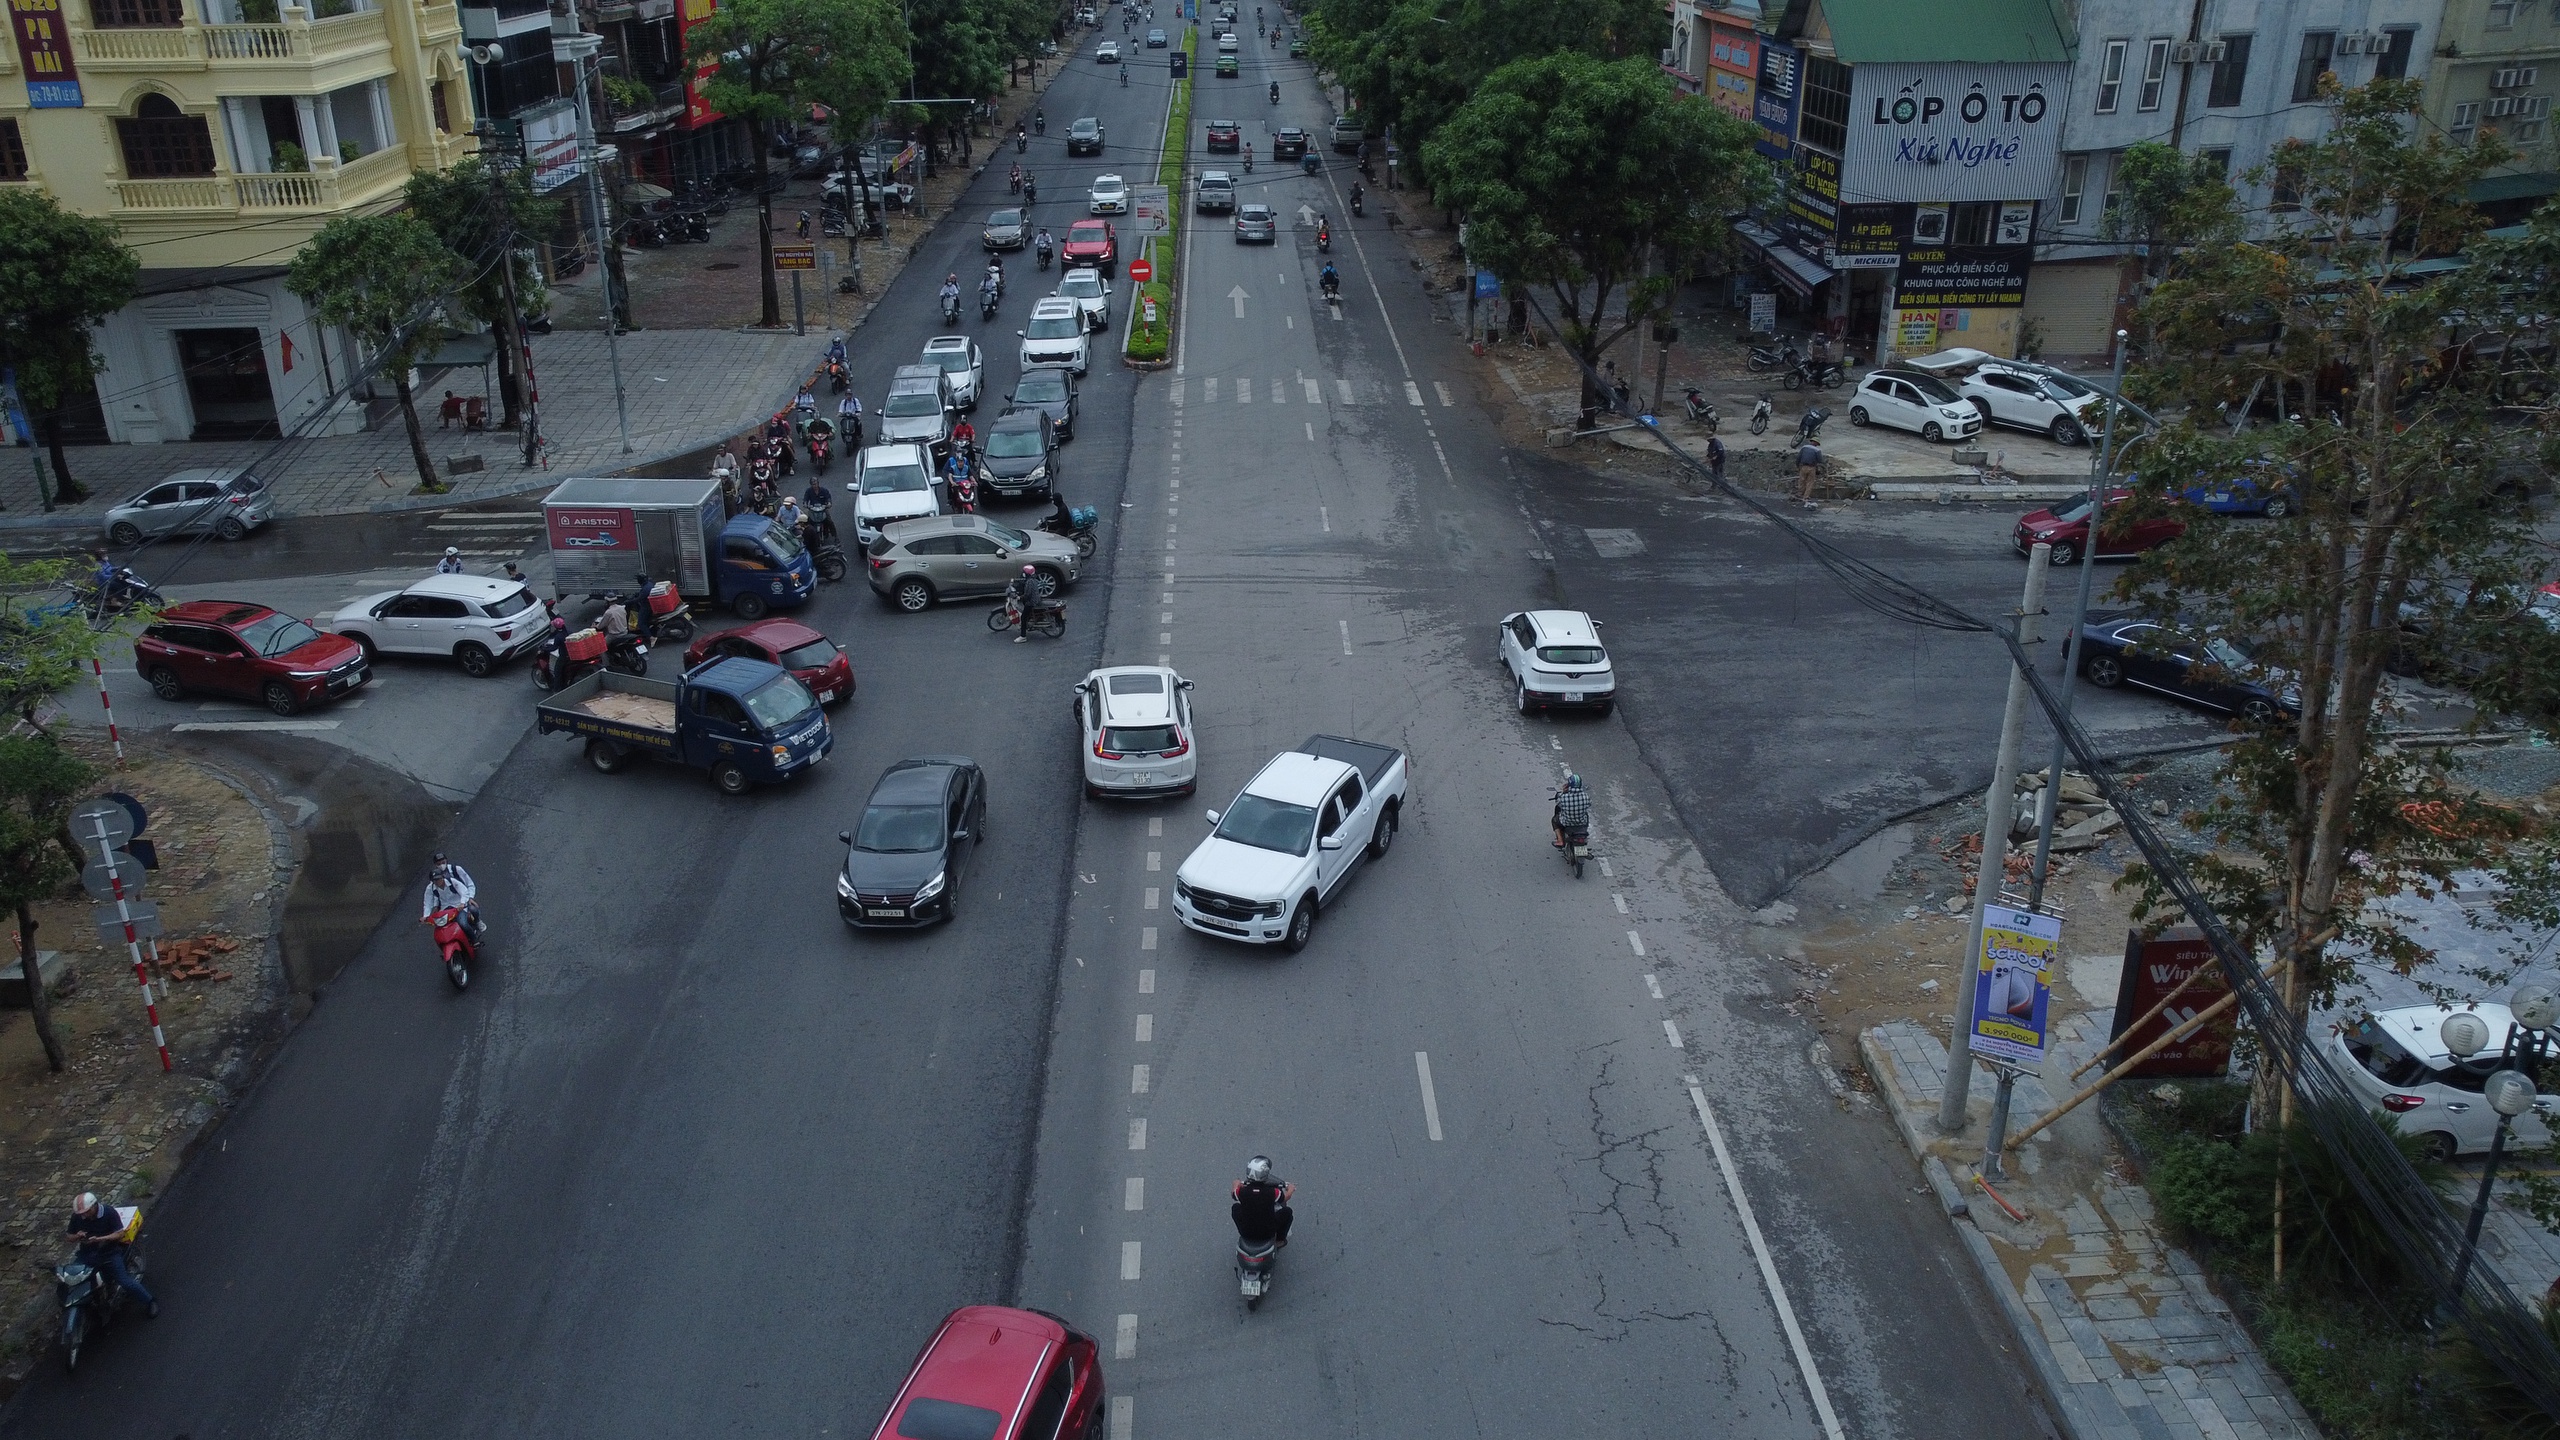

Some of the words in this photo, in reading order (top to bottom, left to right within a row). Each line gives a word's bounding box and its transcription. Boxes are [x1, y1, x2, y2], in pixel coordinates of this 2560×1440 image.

[1874, 78, 1944, 124] LỐP
[1960, 82, 1988, 123] Ô
[2002, 82, 2046, 123] TÔ
[1895, 136, 1939, 162] Xứ
[1945, 136, 2021, 168] Nghệ
[1854, 257, 1897, 265] MICHELIN
[1921, 263, 1944, 275] PHỤC
[1983, 260, 1996, 272] SỐ
[1997, 262, 2009, 272] CŨ
[1904, 278, 1933, 288] KHUNG
[1935, 278, 1954, 287] INOX
[1956, 276, 1980, 287] CÔNG
[1981, 276, 2005, 288] NGHỆ
[2006, 275, 2022, 286] MỚI
[1977, 294, 1986, 304] TY
[1999, 293, 2021, 303] NHANH
[1902, 310, 1937, 322] HÀN
[788, 721, 824, 746] VIETDOOR
[1990, 923, 2052, 939] HOANGHAMOBILE.COM
[1987, 948, 2047, 972] SCHOOL
[2176, 950, 2198, 960] SIÊU
[2163, 1051, 2183, 1060] vào
